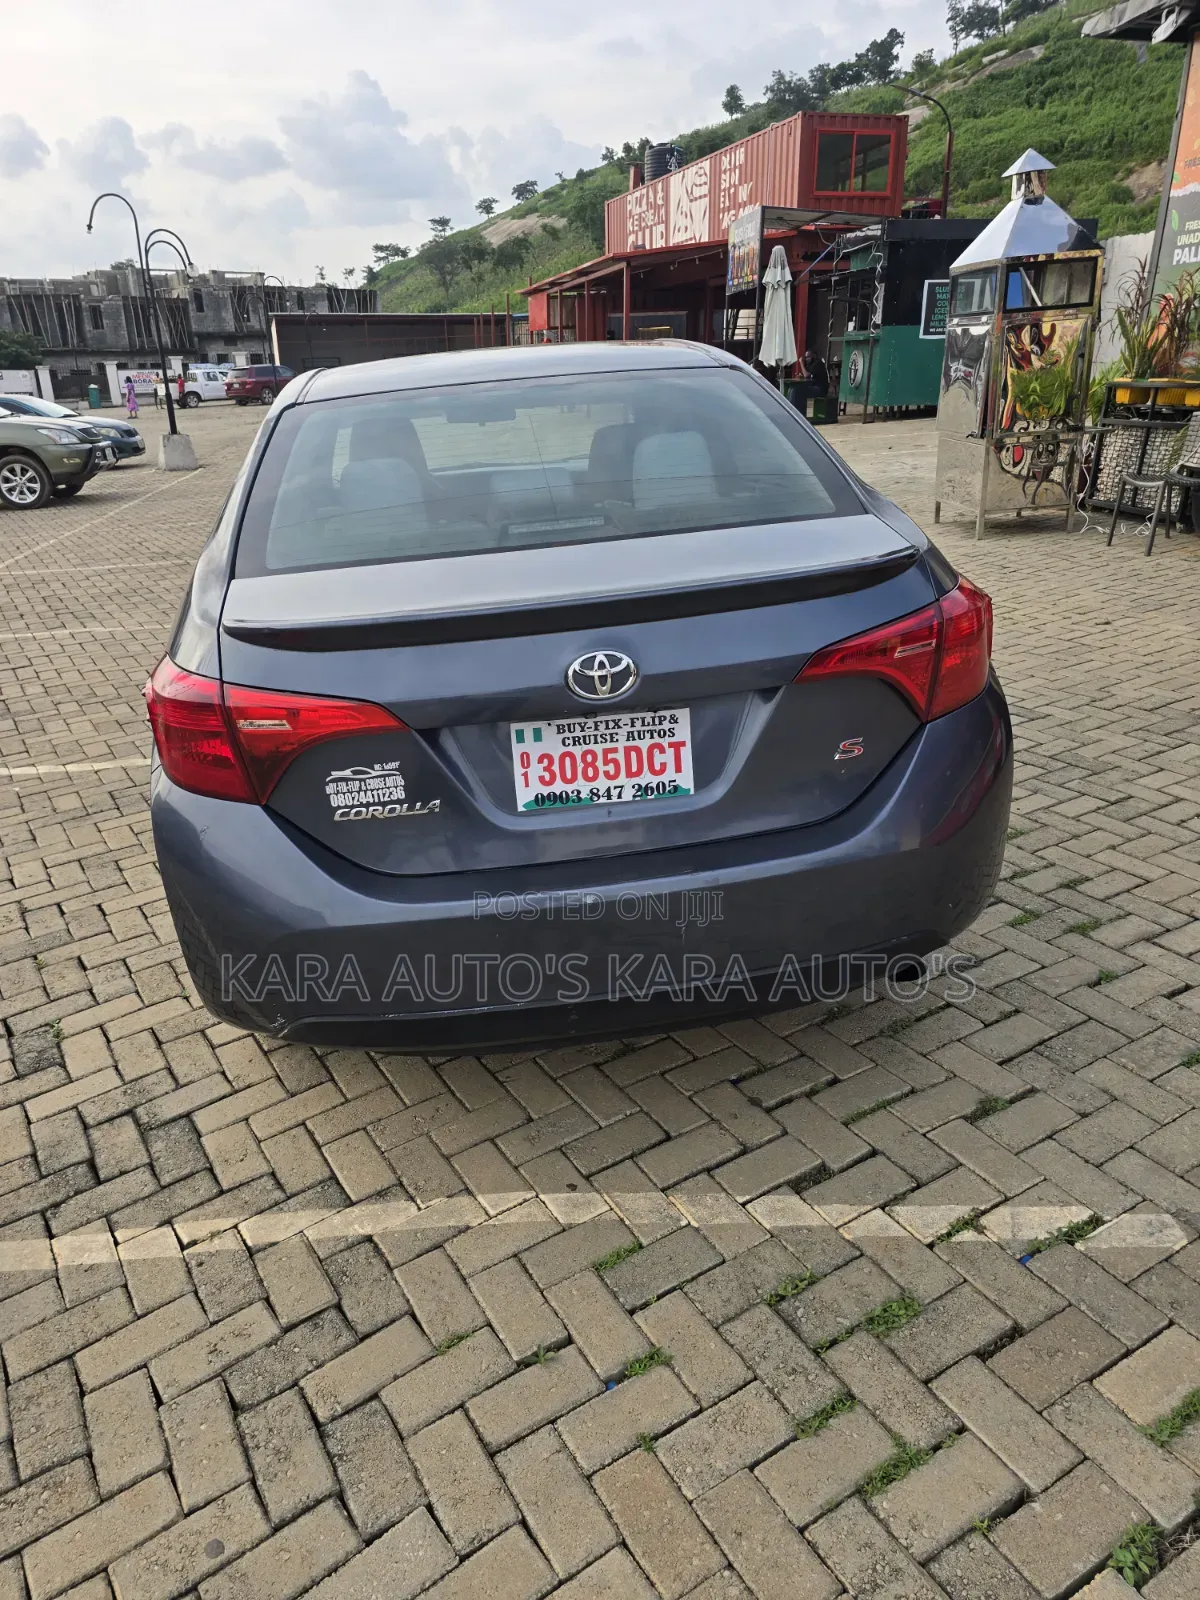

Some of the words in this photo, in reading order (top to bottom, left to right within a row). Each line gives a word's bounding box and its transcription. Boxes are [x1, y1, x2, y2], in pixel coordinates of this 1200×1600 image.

[1184, 156, 1200, 169] FRES
[1184, 220, 1200, 232] FRES
[1177, 232, 1200, 246] UNAD
[561, 731, 619, 747] CRUISE
[625, 727, 676, 742] AUTOS
[834, 737, 864, 760] S
[537, 740, 687, 787] 3085DCT
[329, 786, 406, 807] 08024411236
[534, 788, 582, 808] 0903
[589, 784, 625, 803] 847
[631, 779, 679, 799] 2605
[334, 799, 441, 821] COROLLA
